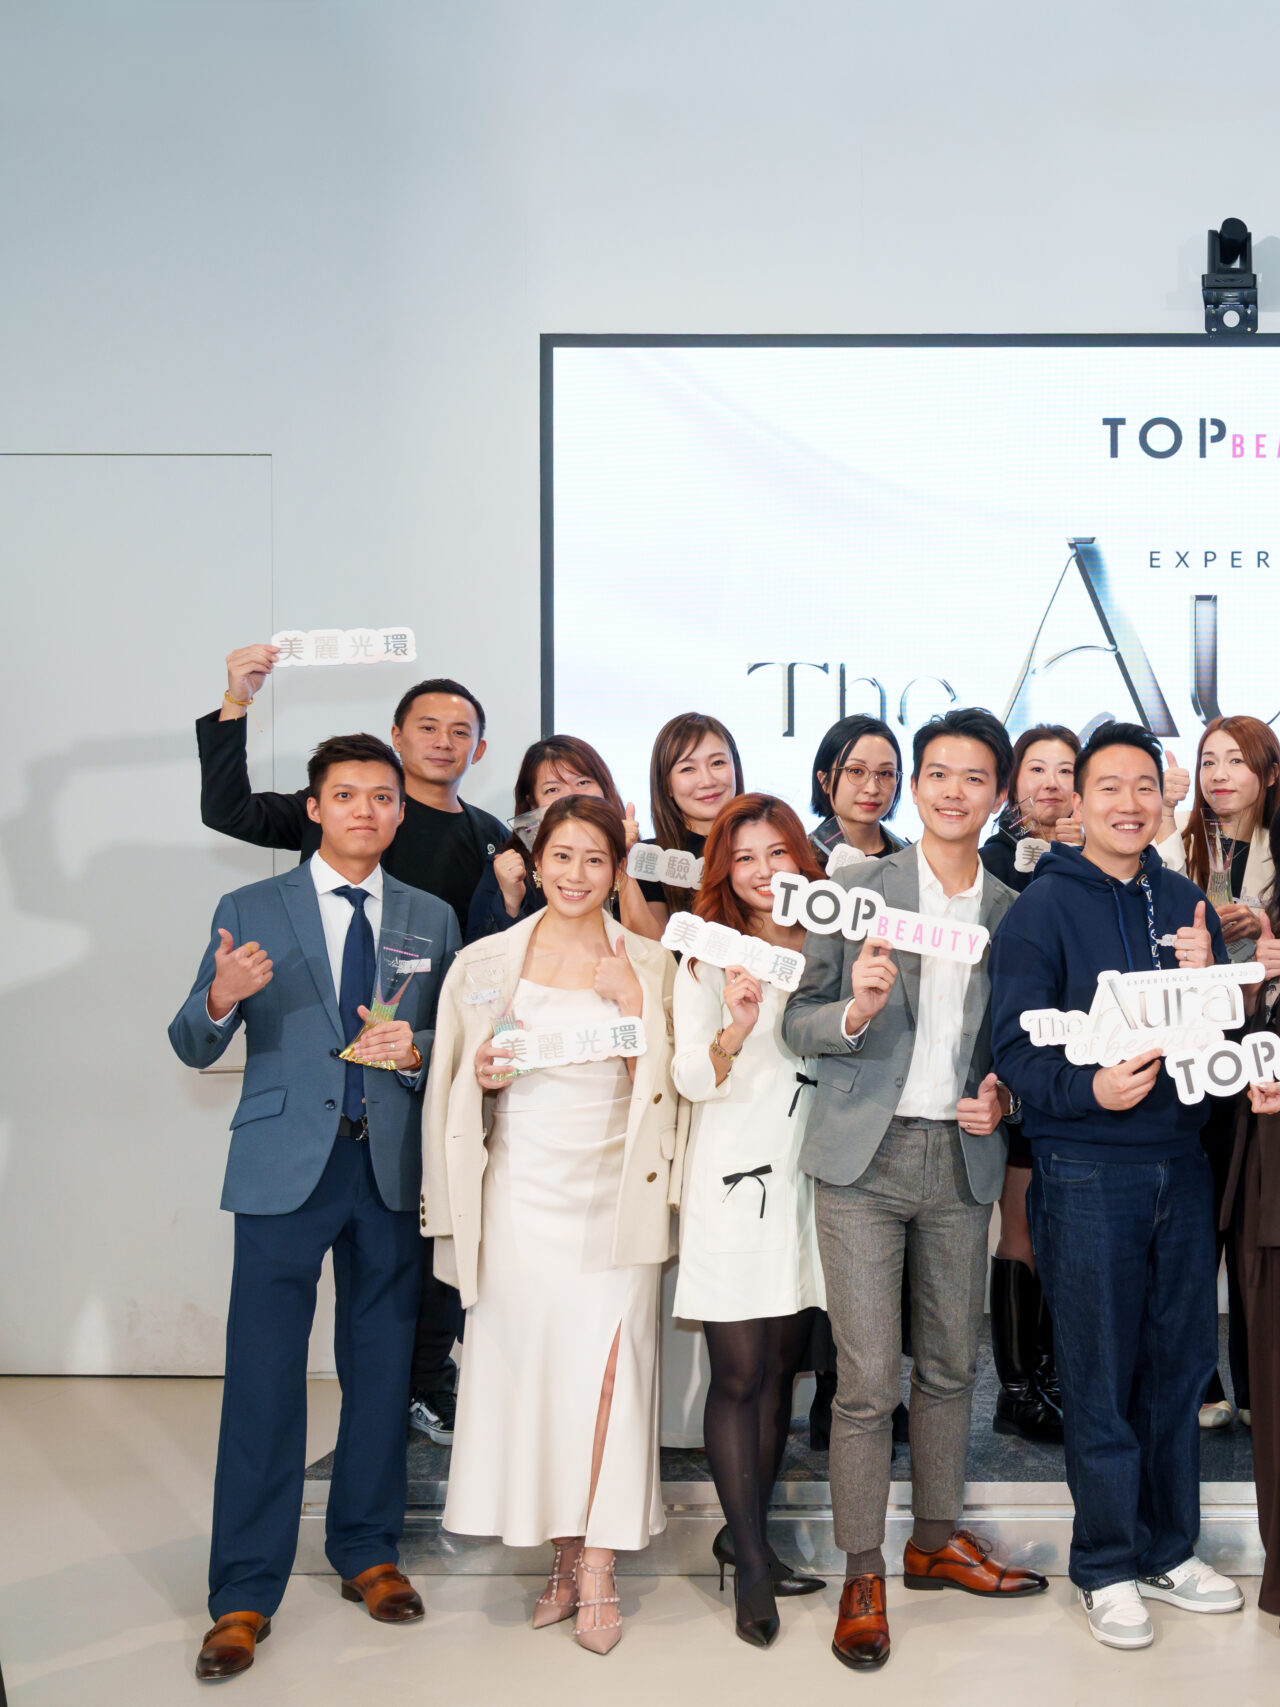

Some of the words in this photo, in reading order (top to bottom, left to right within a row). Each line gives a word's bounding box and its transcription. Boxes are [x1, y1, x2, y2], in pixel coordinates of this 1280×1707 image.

[1102, 416, 1227, 459] TOP
[279, 633, 409, 662] 美麗光環
[635, 849, 704, 884] 體驗
[778, 880, 876, 931] TOP
[877, 914, 981, 956] BEAUTY
[672, 917, 803, 984] 美麗光環
[1126, 975, 1191, 987] EXPERIENCE
[1027, 1015, 1085, 1039] The
[1090, 978, 1238, 1033] Aura
[500, 1023, 639, 1065] 美麗光環
[1175, 1040, 1276, 1095] TOP
